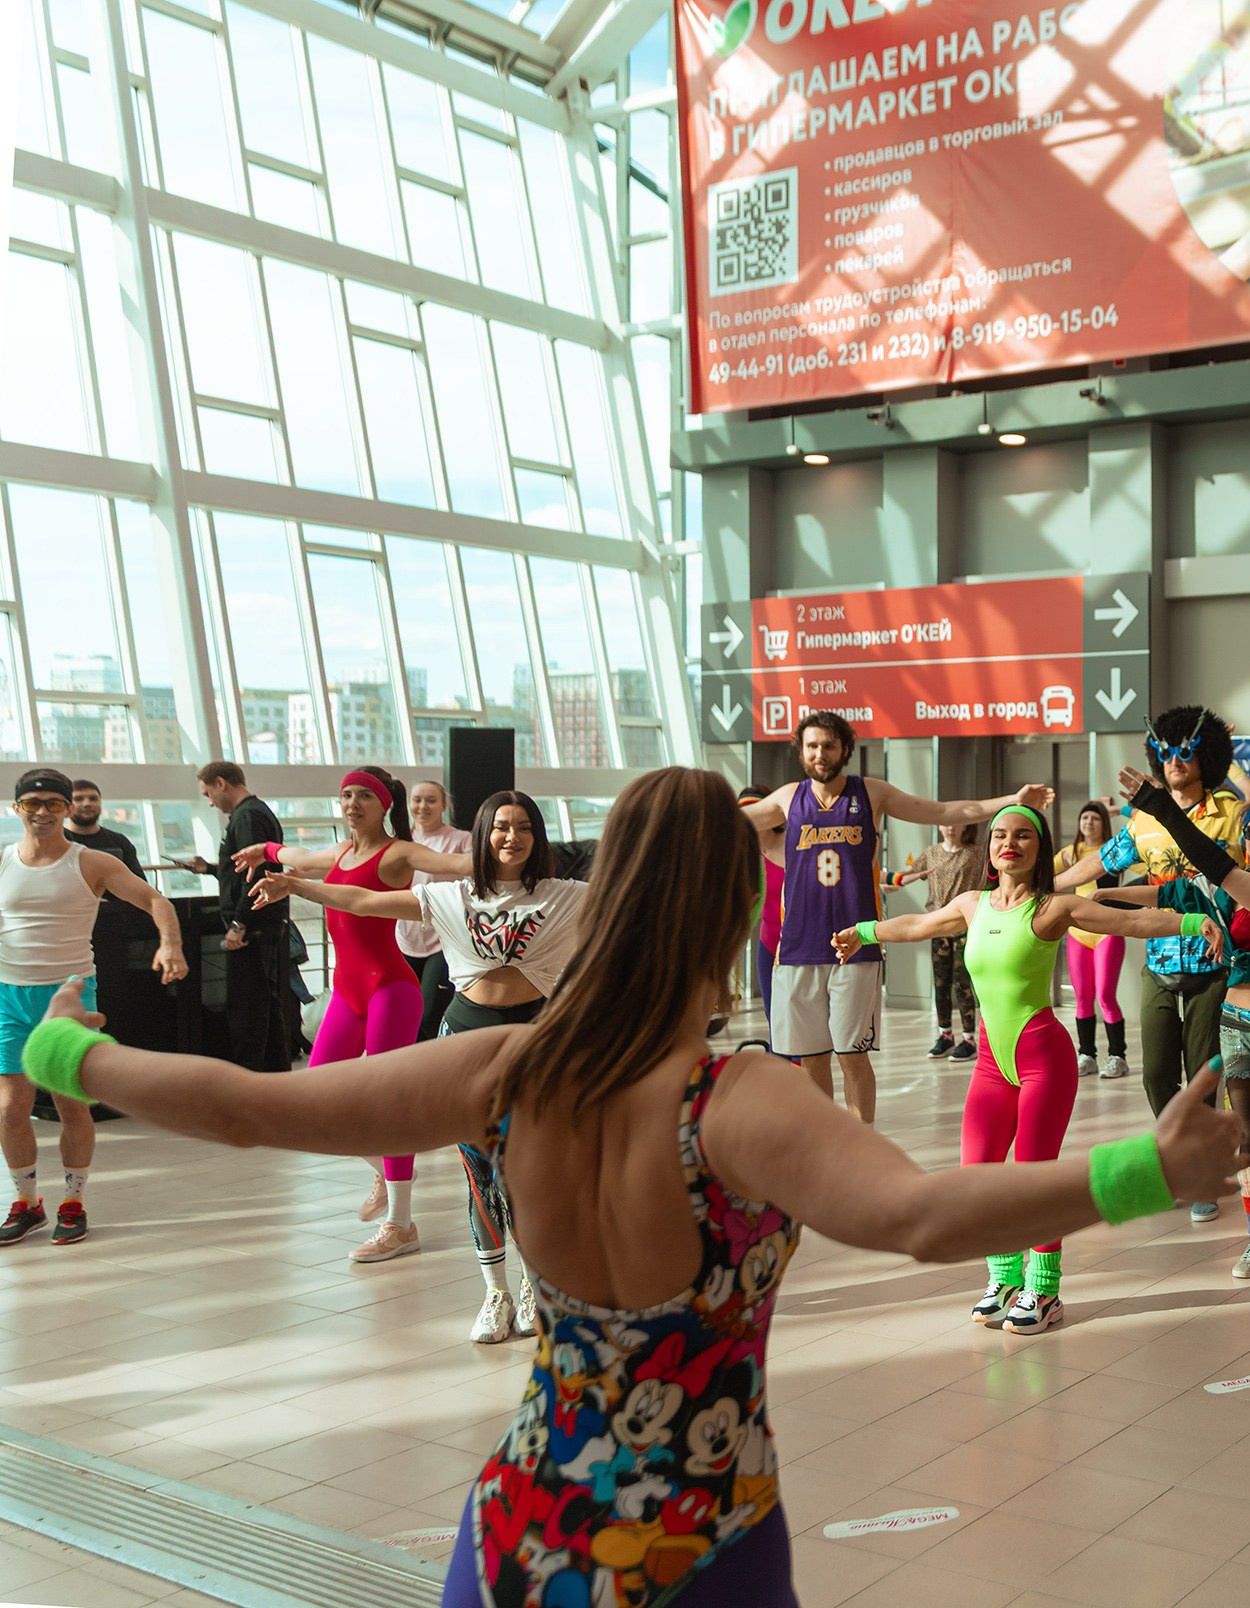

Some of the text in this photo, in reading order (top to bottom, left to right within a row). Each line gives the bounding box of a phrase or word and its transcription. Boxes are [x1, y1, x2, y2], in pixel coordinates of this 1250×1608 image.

[936, 27, 984, 68] НА
[732, 75, 958, 157] ГИПЕРМАРКЕТ
[833, 109, 1064, 174] продавцов в торговый зал
[833, 168, 913, 197] кассиров
[833, 193, 920, 226] грузчиков
[833, 222, 905, 249] поваров
[833, 244, 905, 275] пекарей
[708, 257, 1072, 332] По вопросам трудоустройства обращаться
[708, 337, 718, 353] в
[720, 330, 766, 352] отдел
[769, 317, 855, 343] персонала
[858, 312, 881, 329] по
[708, 302, 1119, 386] 49-44-91 (доб. 231 и 232) и 8-919-950-15-04
[796, 603, 846, 623] 2 этаж
[796, 616, 952, 651] Гипермаркет О'КЕЙ
[798, 676, 848, 695] 1 этаж
[915, 700, 1039, 721] Выход в город
[796, 823, 863, 851] LAKERS
[817, 848, 841, 888] 8
